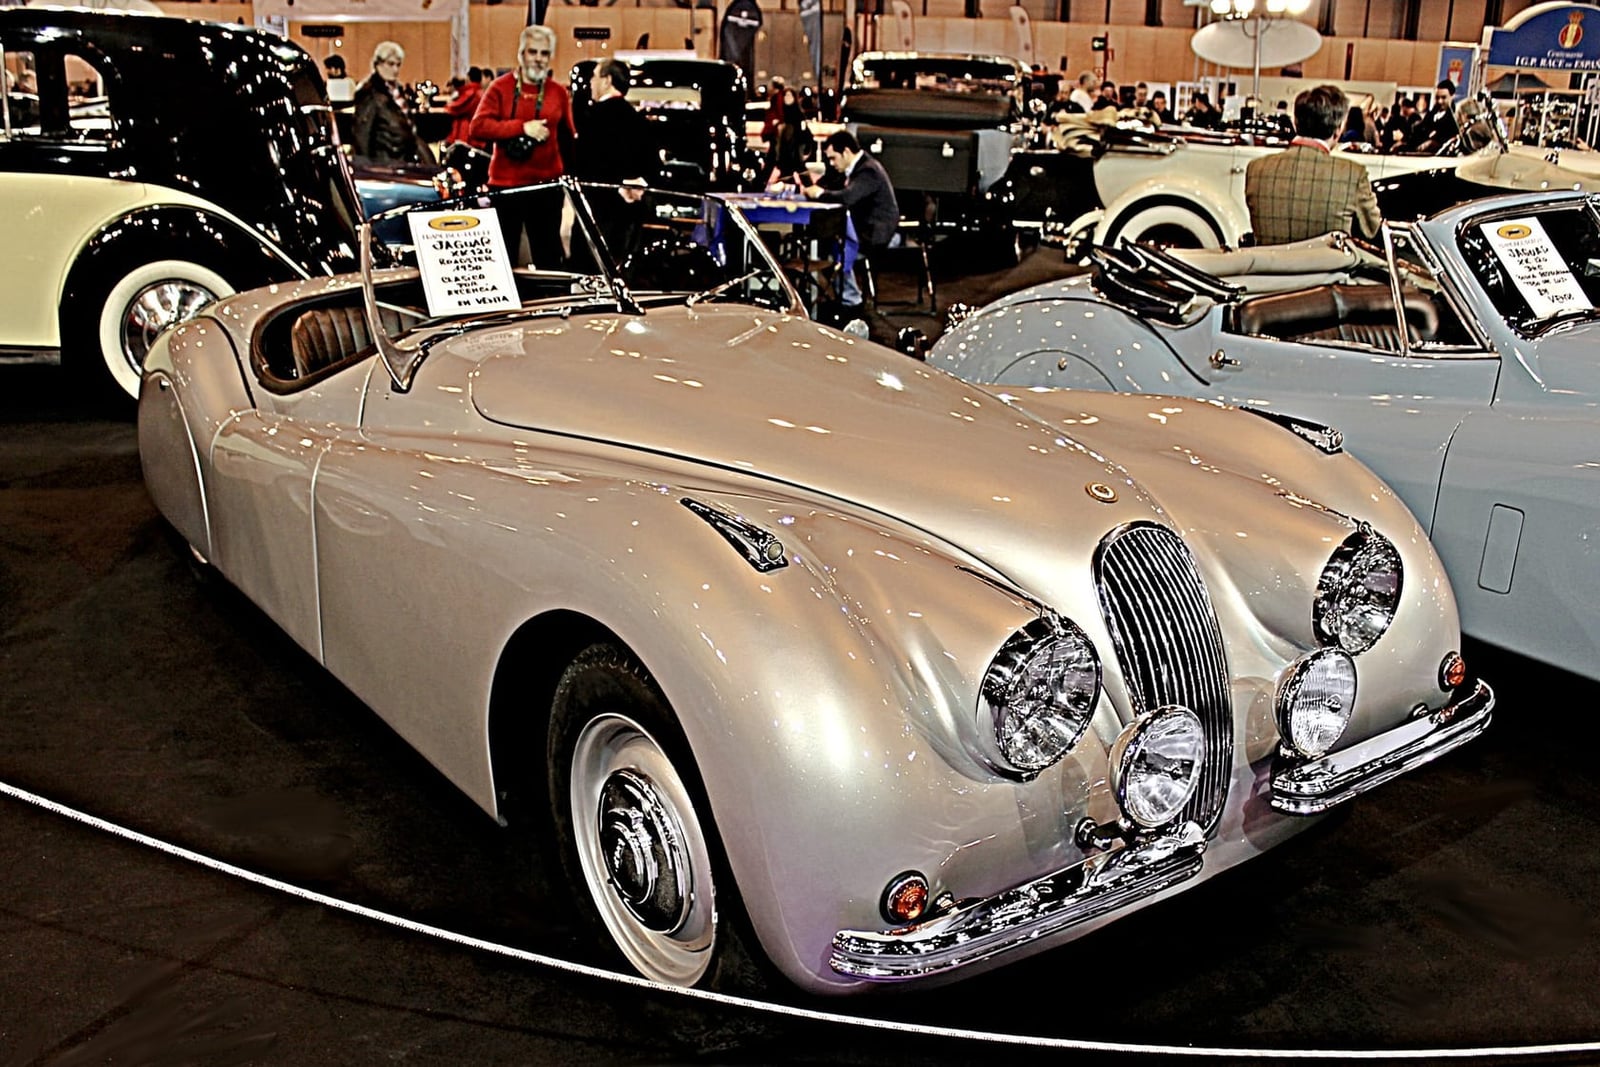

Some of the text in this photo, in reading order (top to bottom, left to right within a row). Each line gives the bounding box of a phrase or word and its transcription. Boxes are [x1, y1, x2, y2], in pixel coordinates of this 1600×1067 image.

[1539, 57, 1565, 68] RACE
[432, 237, 491, 250] JAGUAR
[439, 256, 495, 265] ROADSTER
[453, 264, 482, 272] 1950
[475, 295, 510, 305] VENTA
